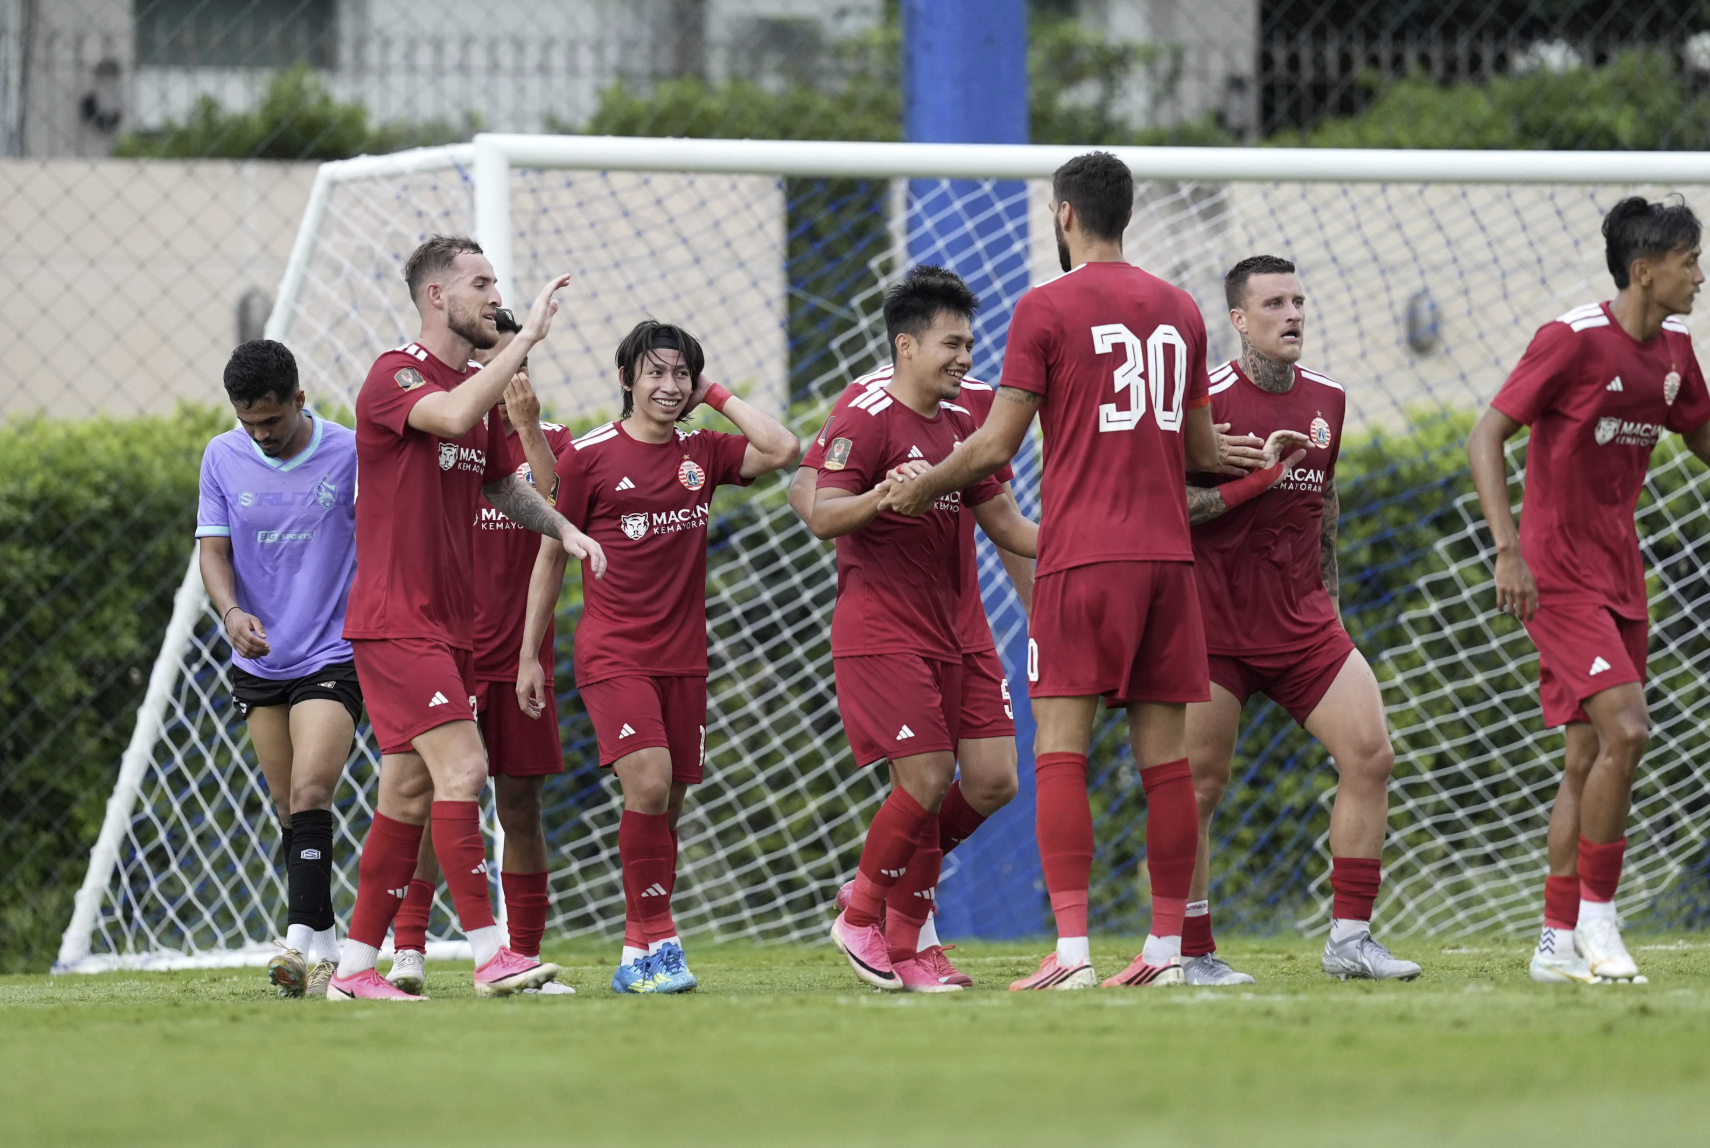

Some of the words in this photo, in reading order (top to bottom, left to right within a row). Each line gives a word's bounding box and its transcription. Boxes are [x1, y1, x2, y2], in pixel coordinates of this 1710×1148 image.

[1090, 323, 1187, 433] 30
[1284, 468, 1324, 484] ACAN
[652, 502, 709, 526] MACAN
[281, 532, 313, 540] SPORTS
